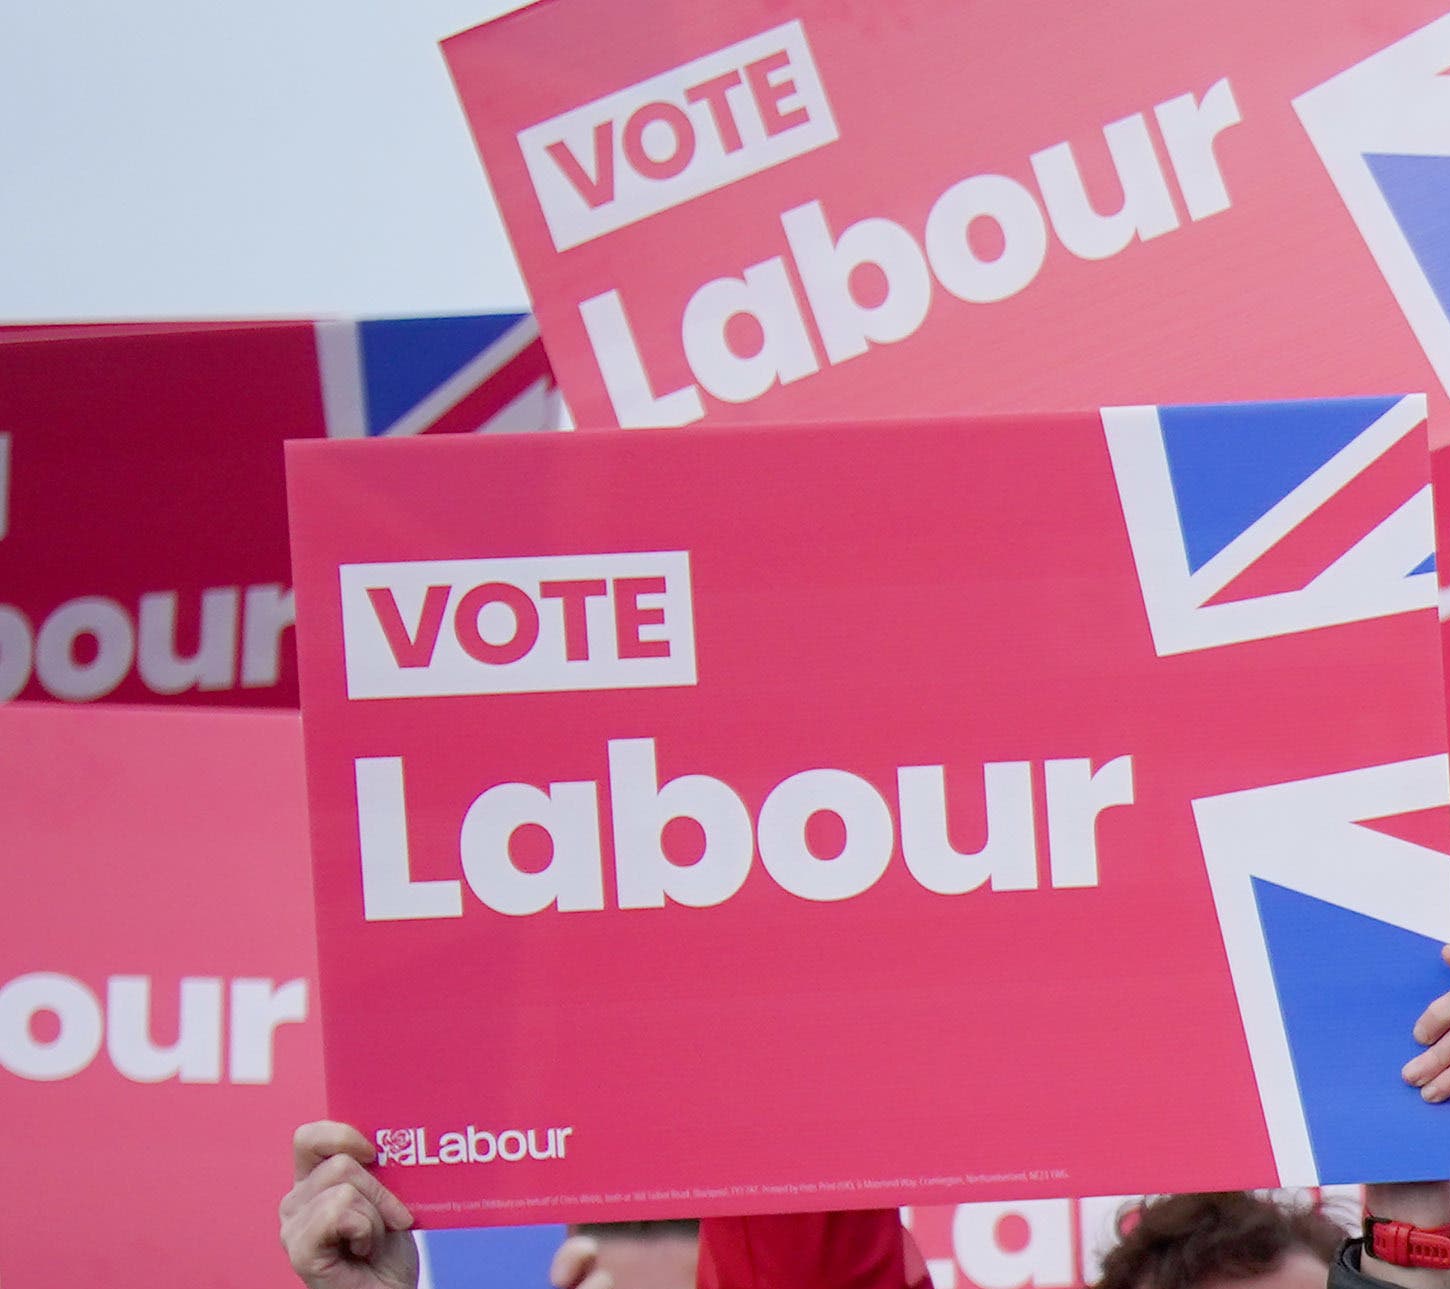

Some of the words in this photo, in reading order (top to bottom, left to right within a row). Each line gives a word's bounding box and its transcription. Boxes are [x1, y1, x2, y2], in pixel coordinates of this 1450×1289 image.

[545, 48, 811, 210] VOTE
[578, 76, 1243, 429] Labour
[367, 575, 671, 670] VOTE
[354, 737, 1134, 922] Labour
[417, 1124, 573, 1166] Labour
